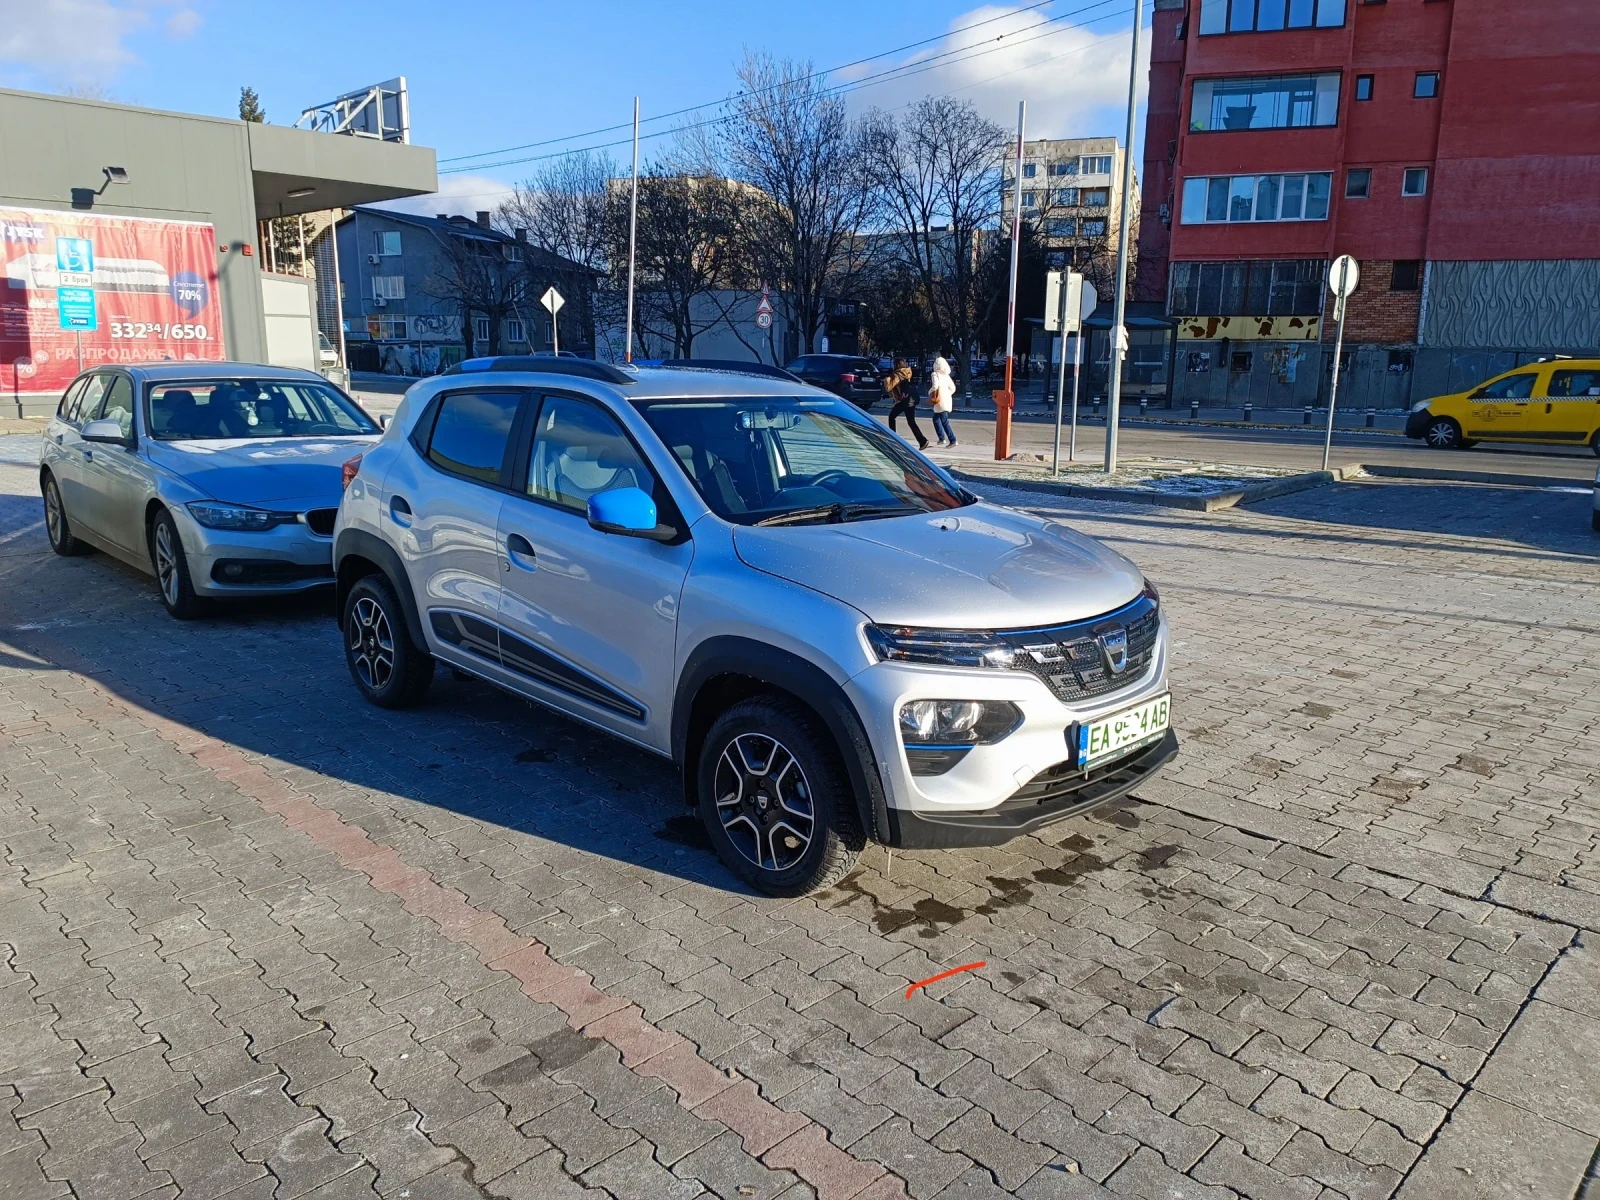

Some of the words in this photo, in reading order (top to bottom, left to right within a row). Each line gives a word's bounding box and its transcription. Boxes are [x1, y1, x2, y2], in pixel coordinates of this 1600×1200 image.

[178, 290, 202, 301] 70%
[760, 315, 769, 324] 30
[1090, 723, 1110, 755] EA
[1150, 701, 1167, 730] AB
